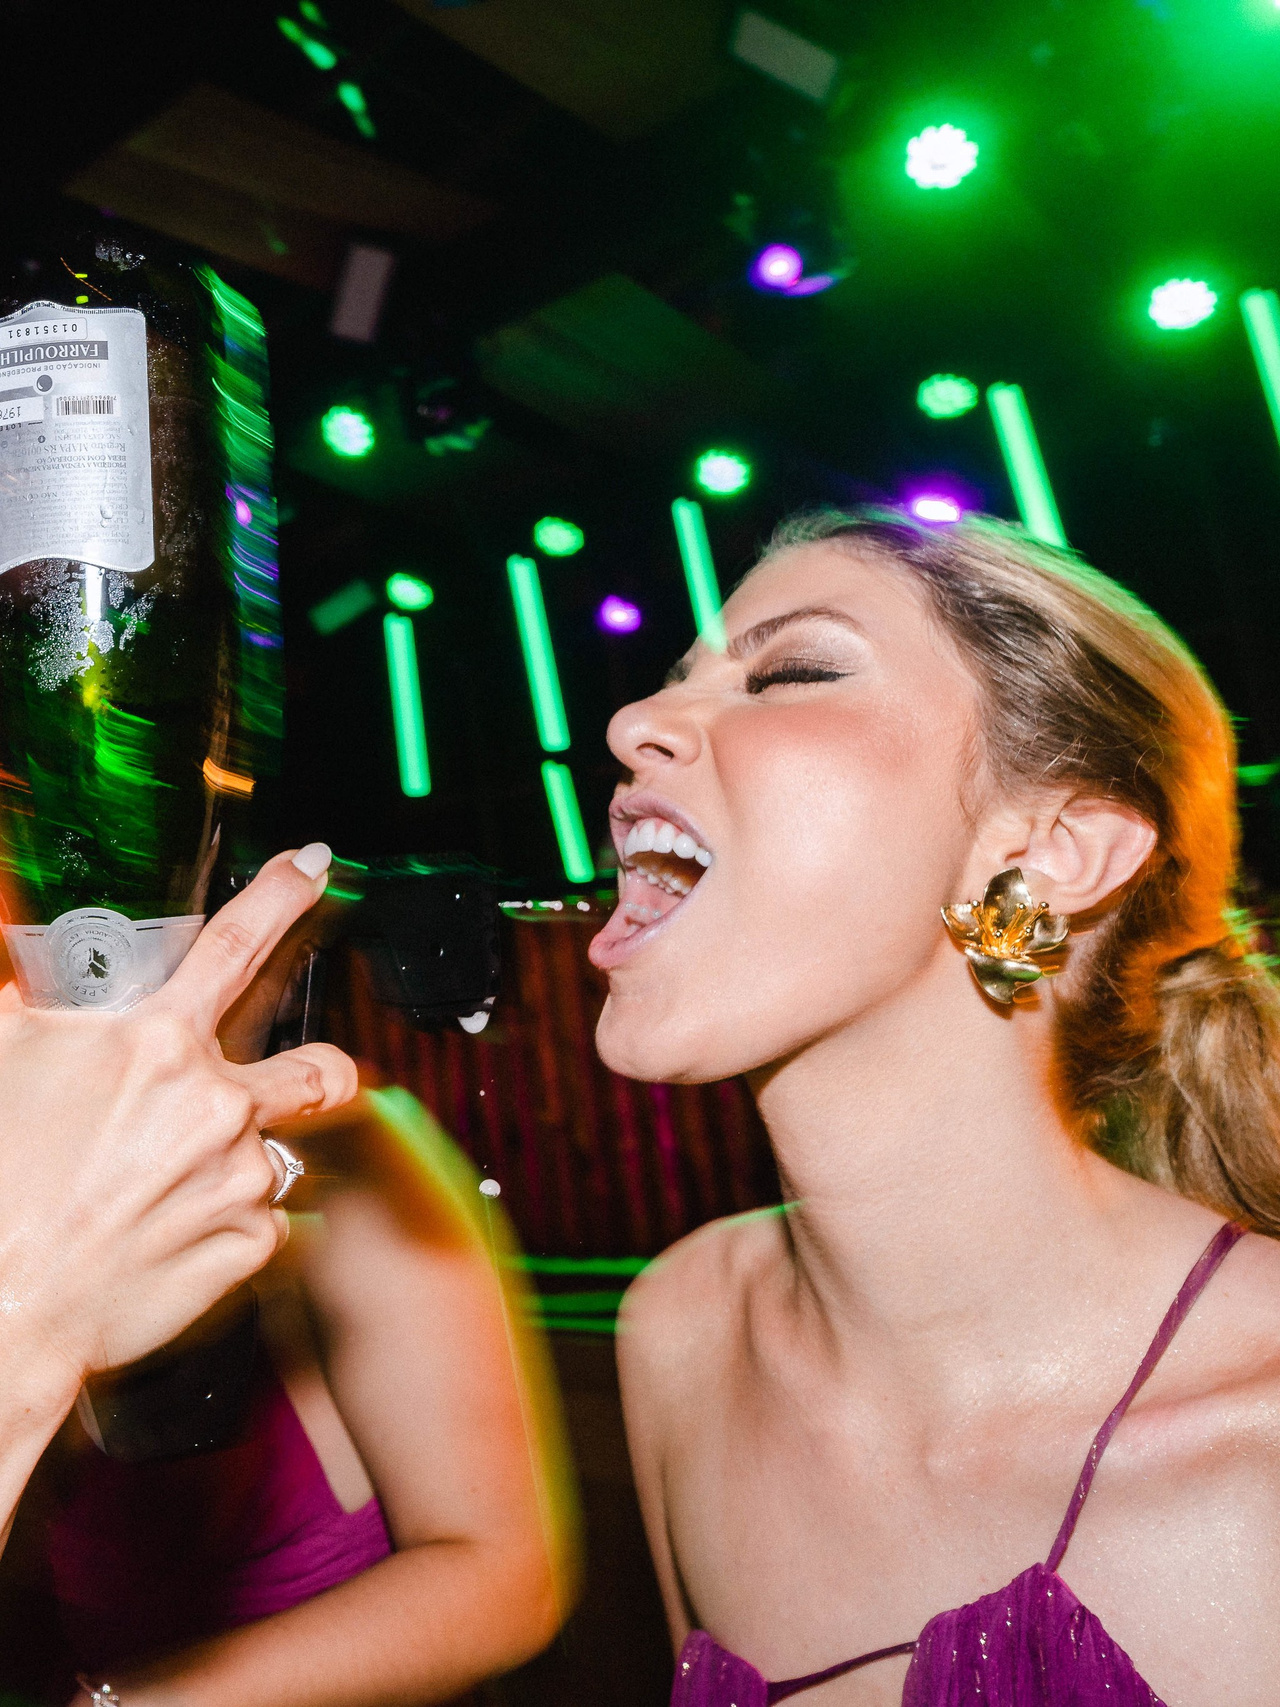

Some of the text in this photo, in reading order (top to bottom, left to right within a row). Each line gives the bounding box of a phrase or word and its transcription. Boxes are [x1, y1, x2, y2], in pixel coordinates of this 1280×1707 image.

[8, 323, 77, 339] 01351831
[56, 362, 100, 371] INDICAÇÃO
[0, 422, 21, 432] LOTE
[43, 444, 56, 453] RS
[59, 443, 88, 452] MAPA
[90, 440, 125, 452] Registro
